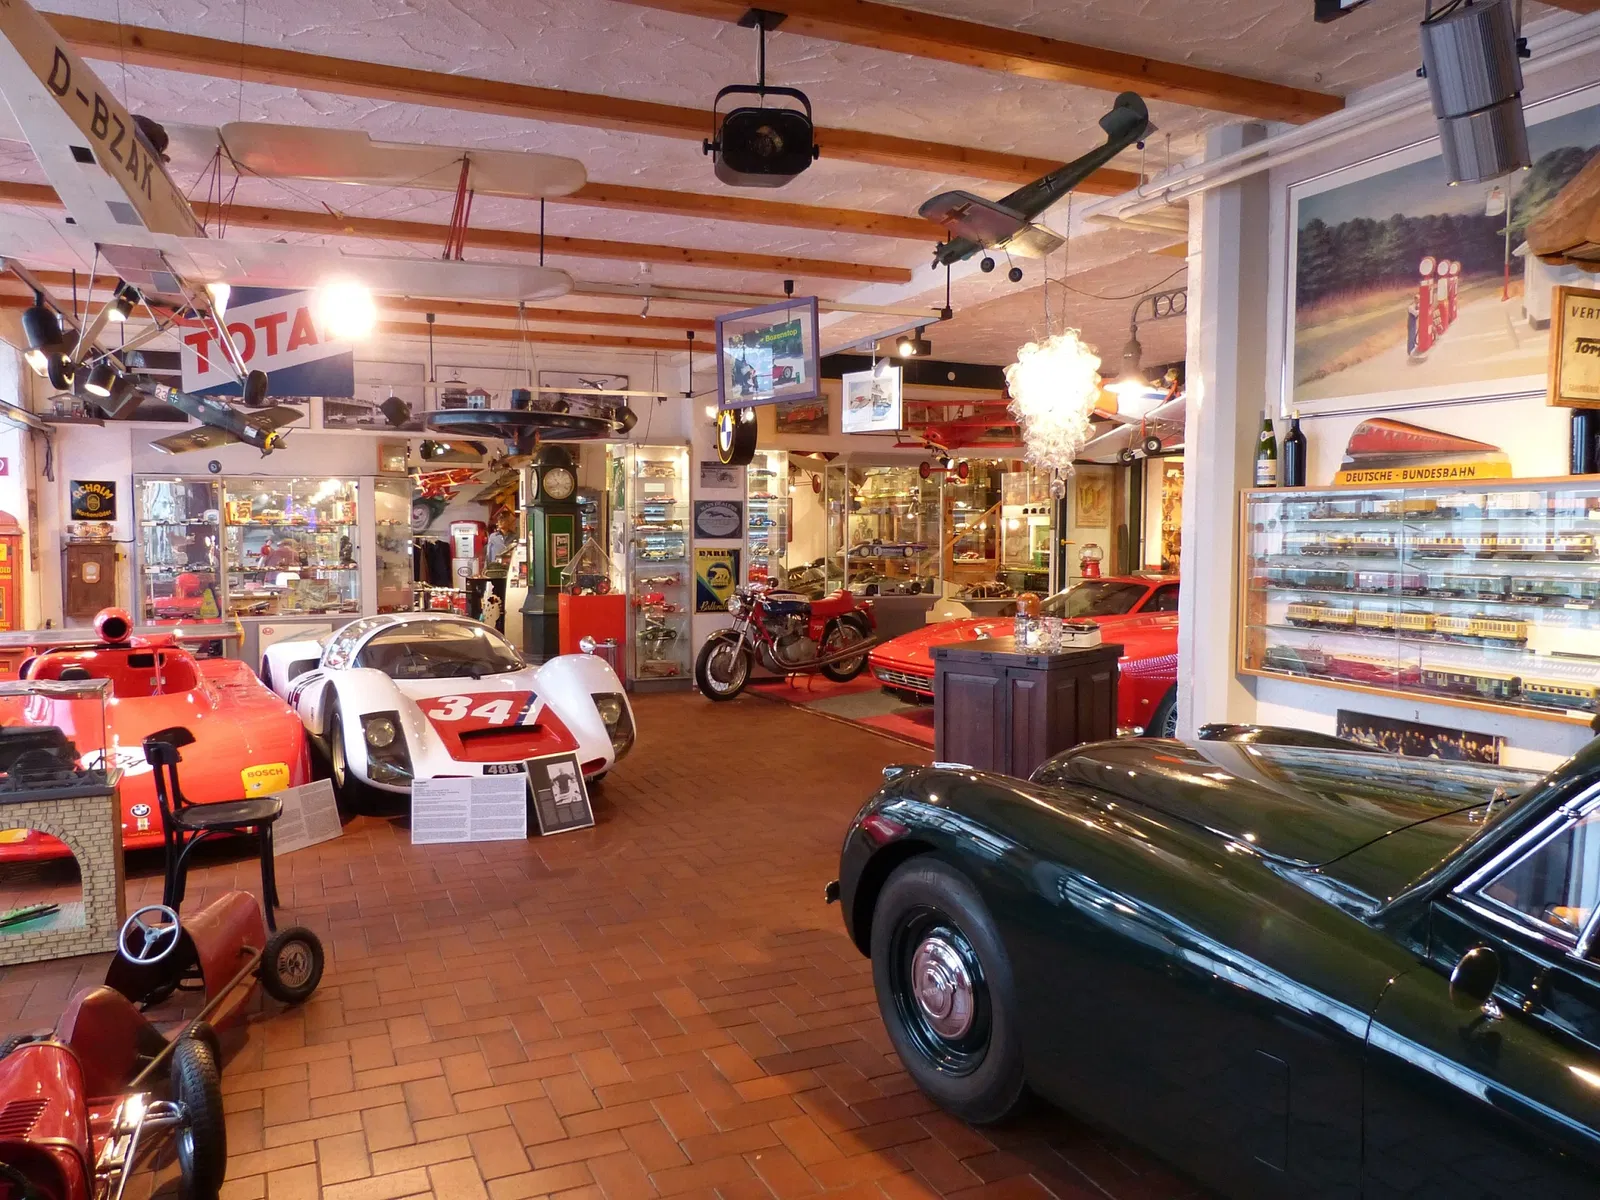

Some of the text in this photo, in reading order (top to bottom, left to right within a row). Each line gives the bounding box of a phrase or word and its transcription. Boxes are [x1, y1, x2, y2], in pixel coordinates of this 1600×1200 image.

[47, 46, 154, 201] D-BZAK
[184, 302, 345, 374] TOTA
[765, 329, 798, 342] Boxenstop
[1346, 471, 1392, 482] DEUTSCHE
[1402, 466, 1475, 480] BUNDESBAHN
[73, 484, 114, 499] ACHALM
[428, 695, 514, 725] 34
[247, 768, 284, 778] BOSCH
[488, 764, 519, 775] 486
